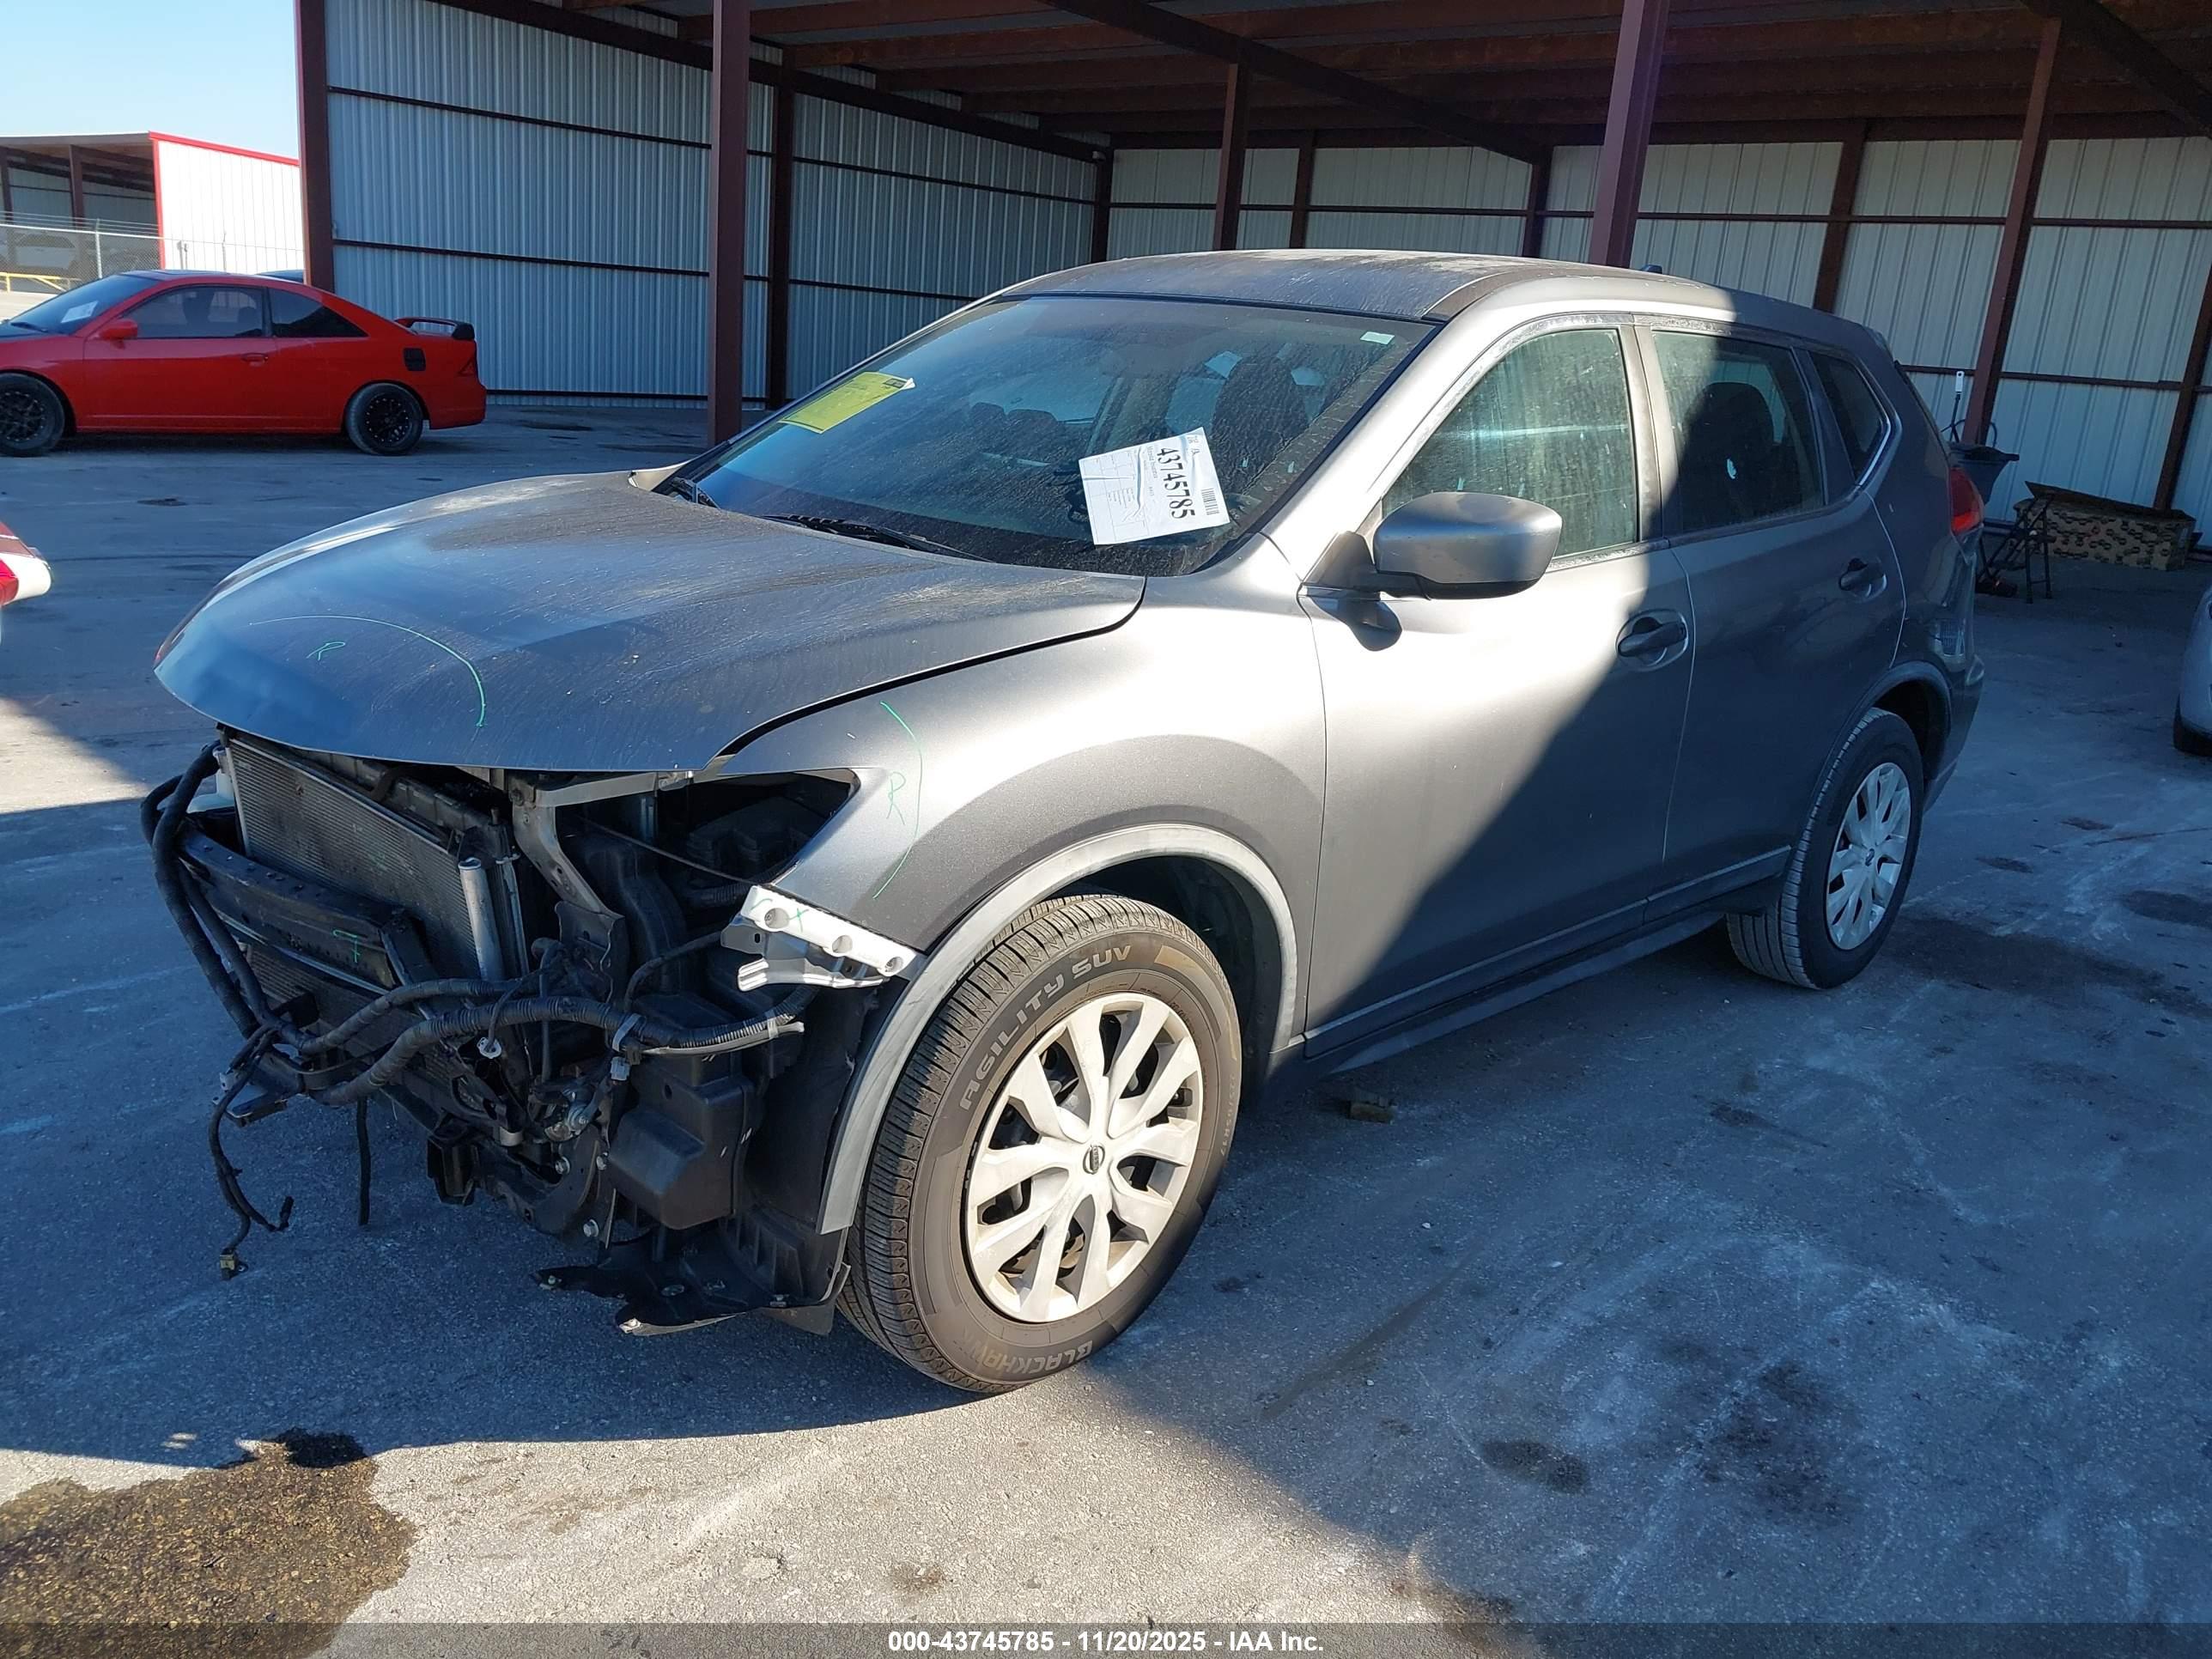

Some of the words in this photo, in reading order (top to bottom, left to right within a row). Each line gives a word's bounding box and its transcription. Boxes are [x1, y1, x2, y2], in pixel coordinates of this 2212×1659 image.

[1157, 447, 1196, 519] 43745785
[959, 974, 1066, 1111] AGILITY
[1072, 945, 1132, 980] SUV
